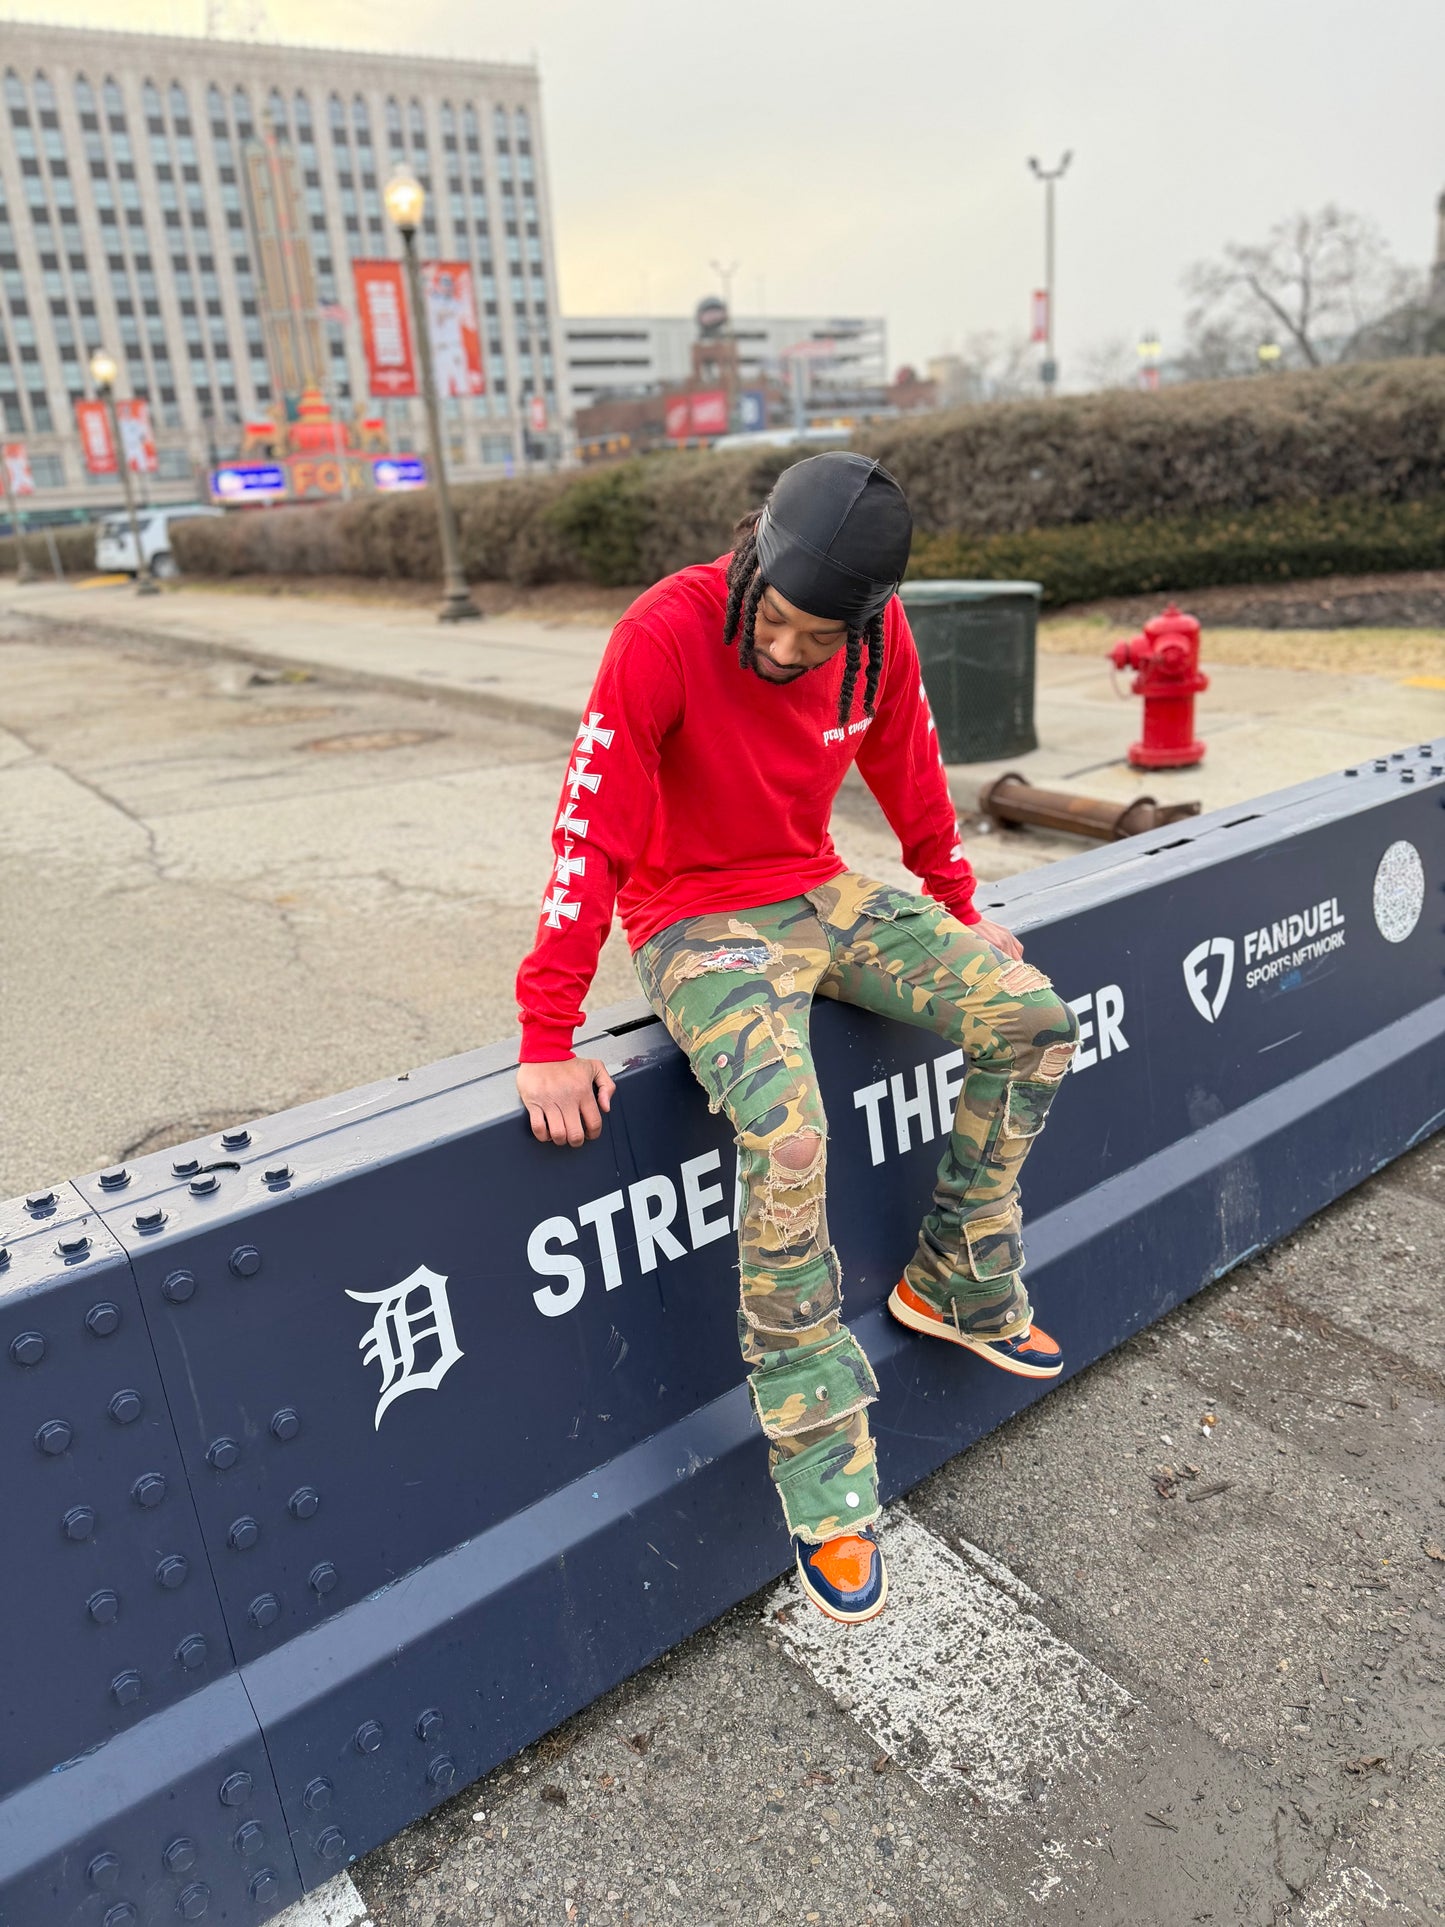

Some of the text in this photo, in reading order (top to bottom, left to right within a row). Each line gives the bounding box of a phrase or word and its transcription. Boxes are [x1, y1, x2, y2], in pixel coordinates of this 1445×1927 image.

[823, 727, 845, 747] pray
[1244, 897, 1345, 965] FANDUEL
[1246, 929, 1346, 989] SPORTS NETWORK
[526, 1147, 741, 1317] STRE
[344, 1264, 465, 1431] D
